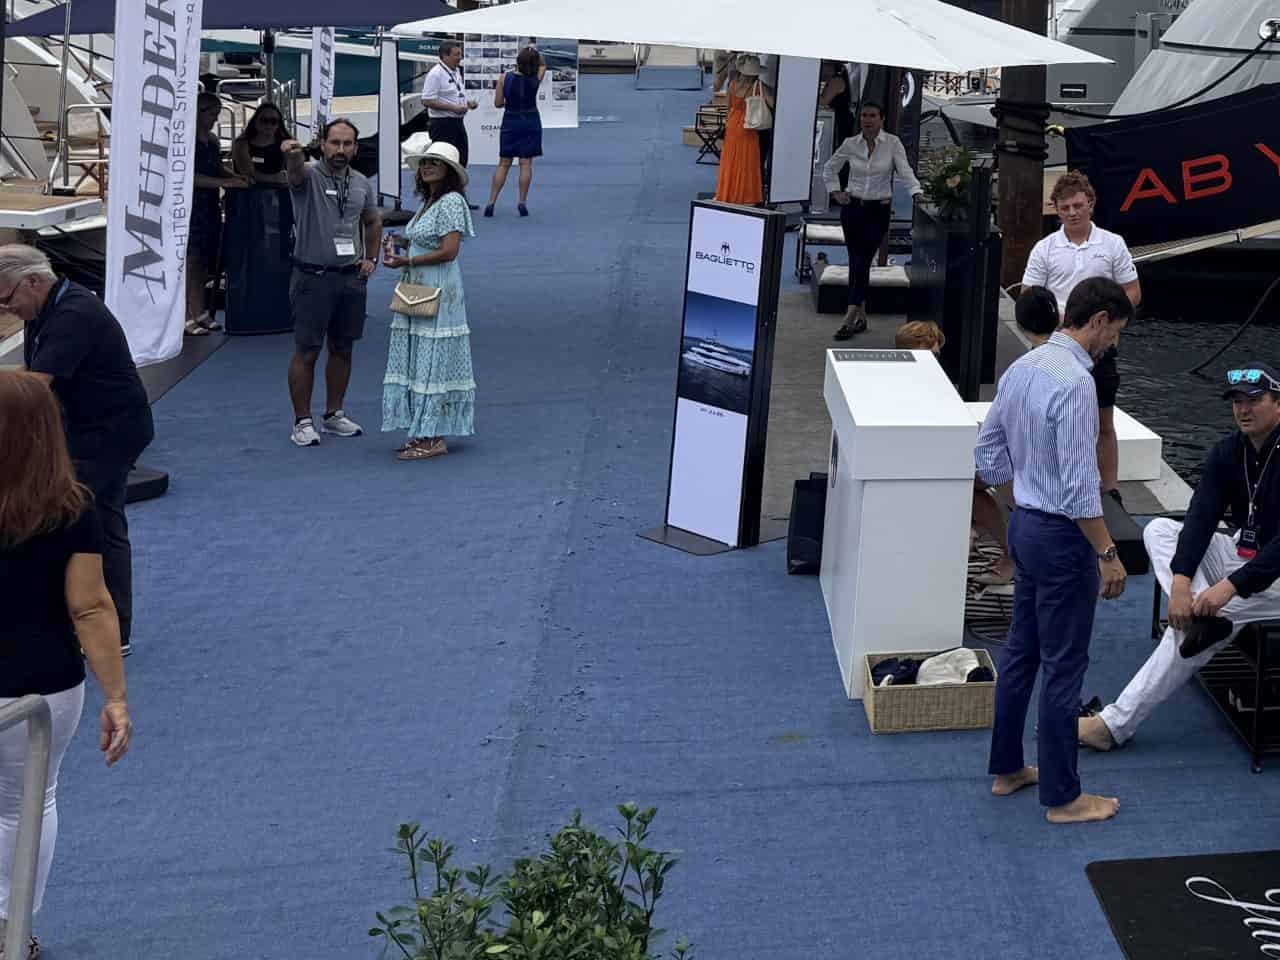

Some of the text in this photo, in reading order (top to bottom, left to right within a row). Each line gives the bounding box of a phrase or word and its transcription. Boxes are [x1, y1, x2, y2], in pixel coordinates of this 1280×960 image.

[171, 119, 187, 280] ACHTBUILDERS
[1119, 154, 1233, 213] AB
[695, 250, 755, 271] BAGLIETTO
